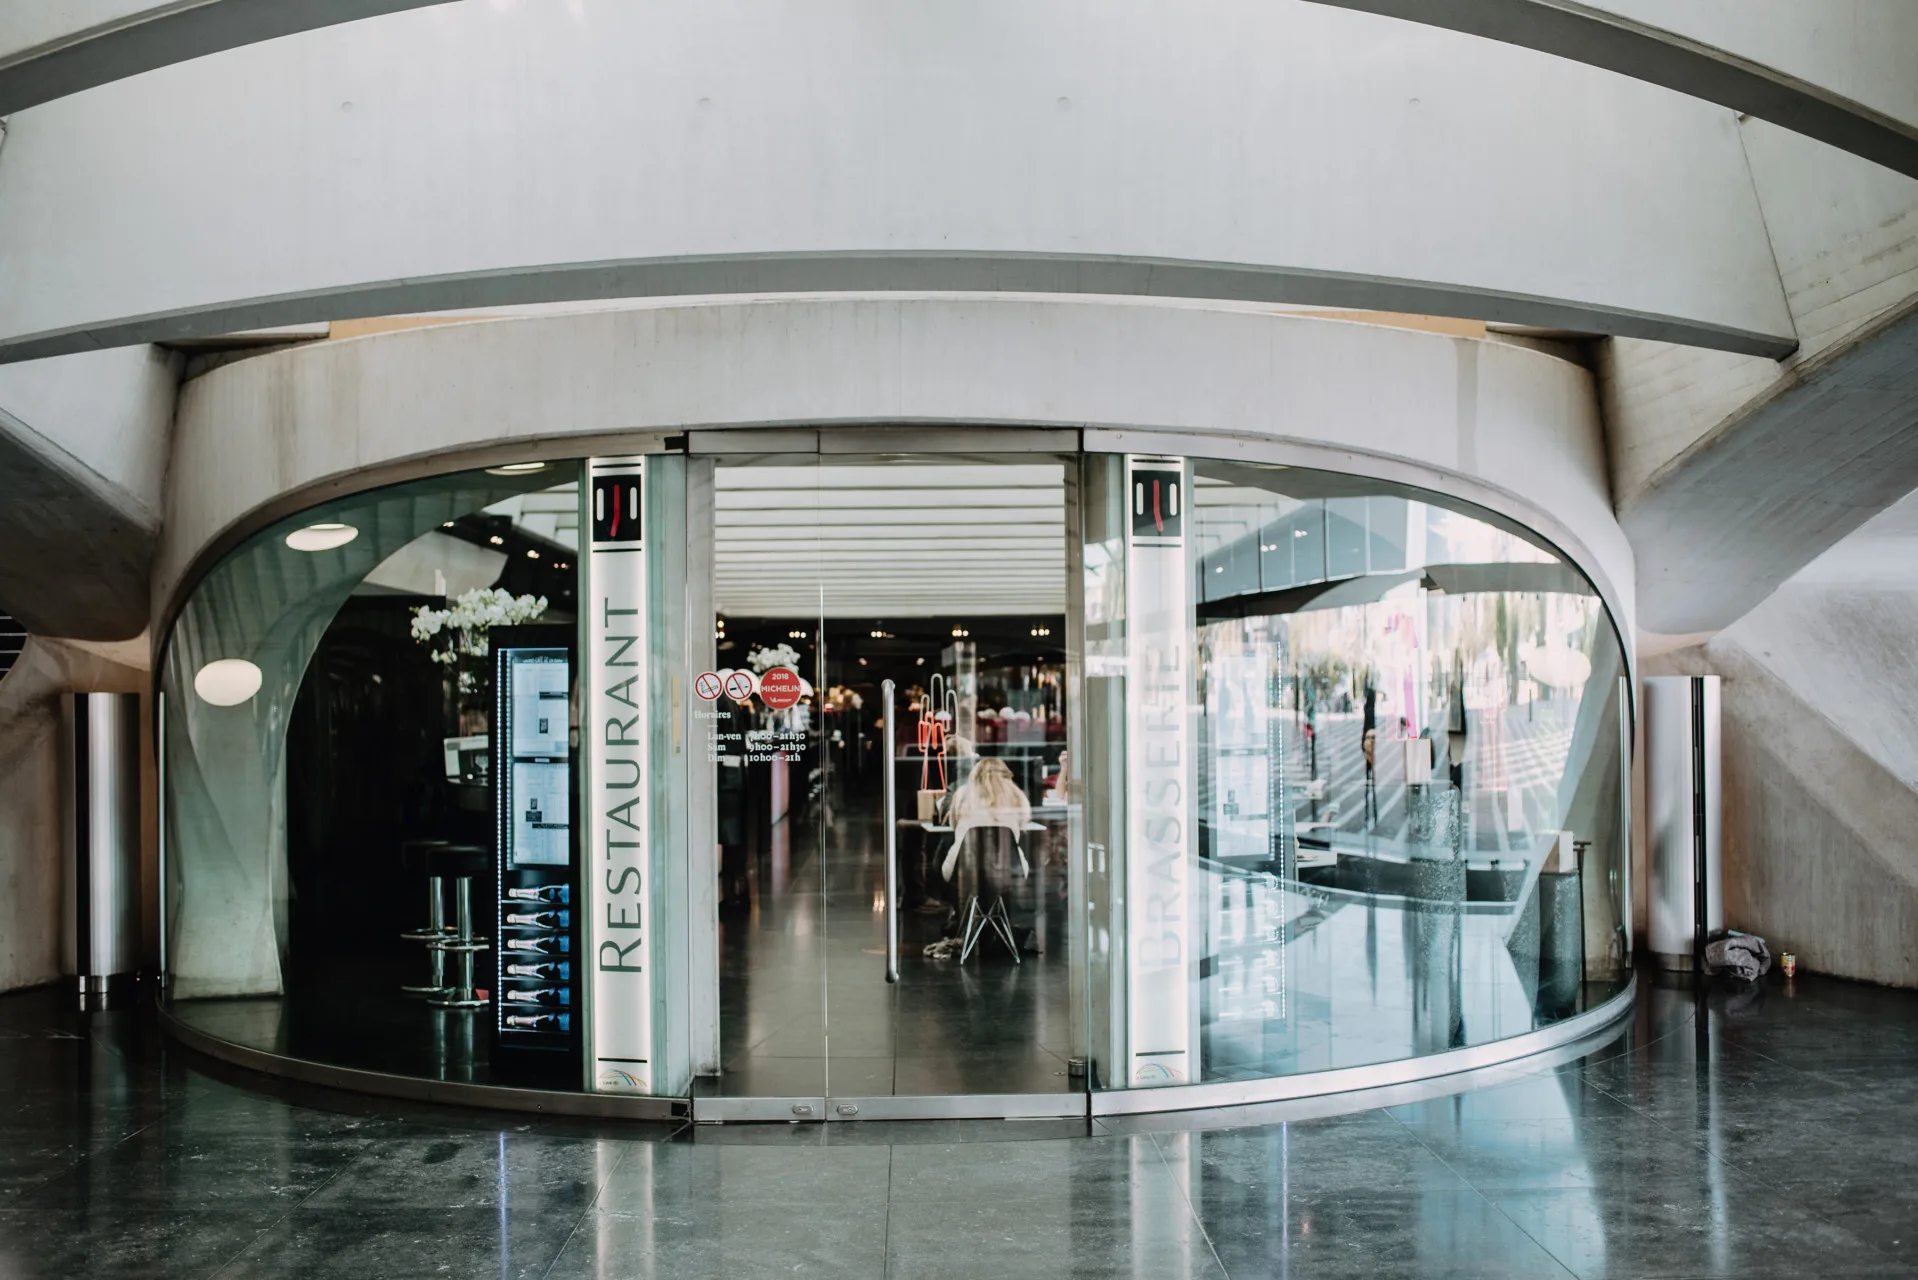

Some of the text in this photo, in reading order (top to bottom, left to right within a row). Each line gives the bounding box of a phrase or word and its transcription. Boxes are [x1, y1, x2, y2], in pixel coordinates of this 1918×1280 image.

[694, 710, 732, 719] Horaires
[708, 742, 726, 751] Sam
[708, 753, 726, 762] Dim
[600, 597, 642, 973] RESTAURANT
[1138, 645, 1182, 967] BRASSERIE
